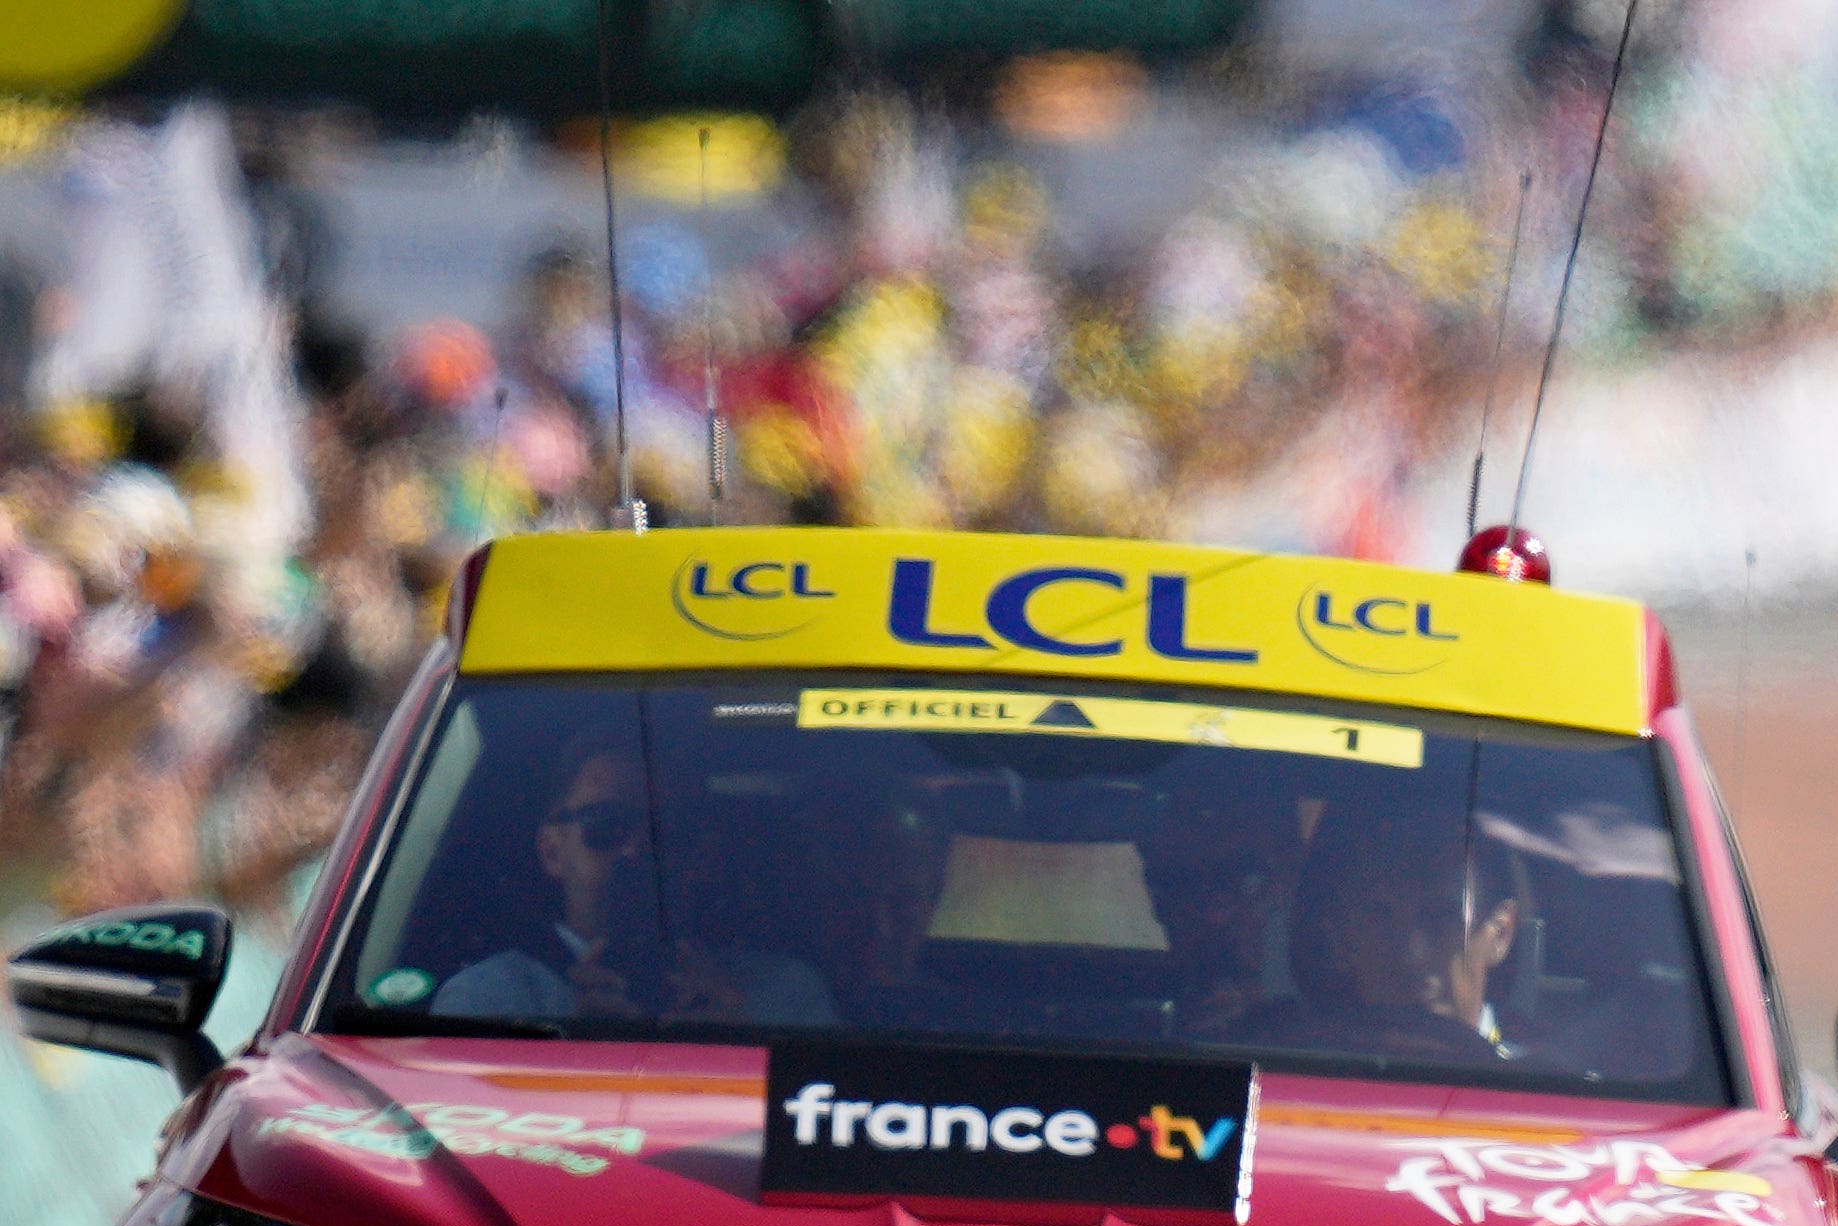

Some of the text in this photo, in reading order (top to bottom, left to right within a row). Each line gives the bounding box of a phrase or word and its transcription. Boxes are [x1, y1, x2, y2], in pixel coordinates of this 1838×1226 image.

[689, 561, 837, 601] LCL
[885, 557, 1260, 666] LCL
[1314, 592, 1460, 642] LCL
[820, 698, 1018, 721] OFFICIEL
[1330, 726, 1361, 753] 1
